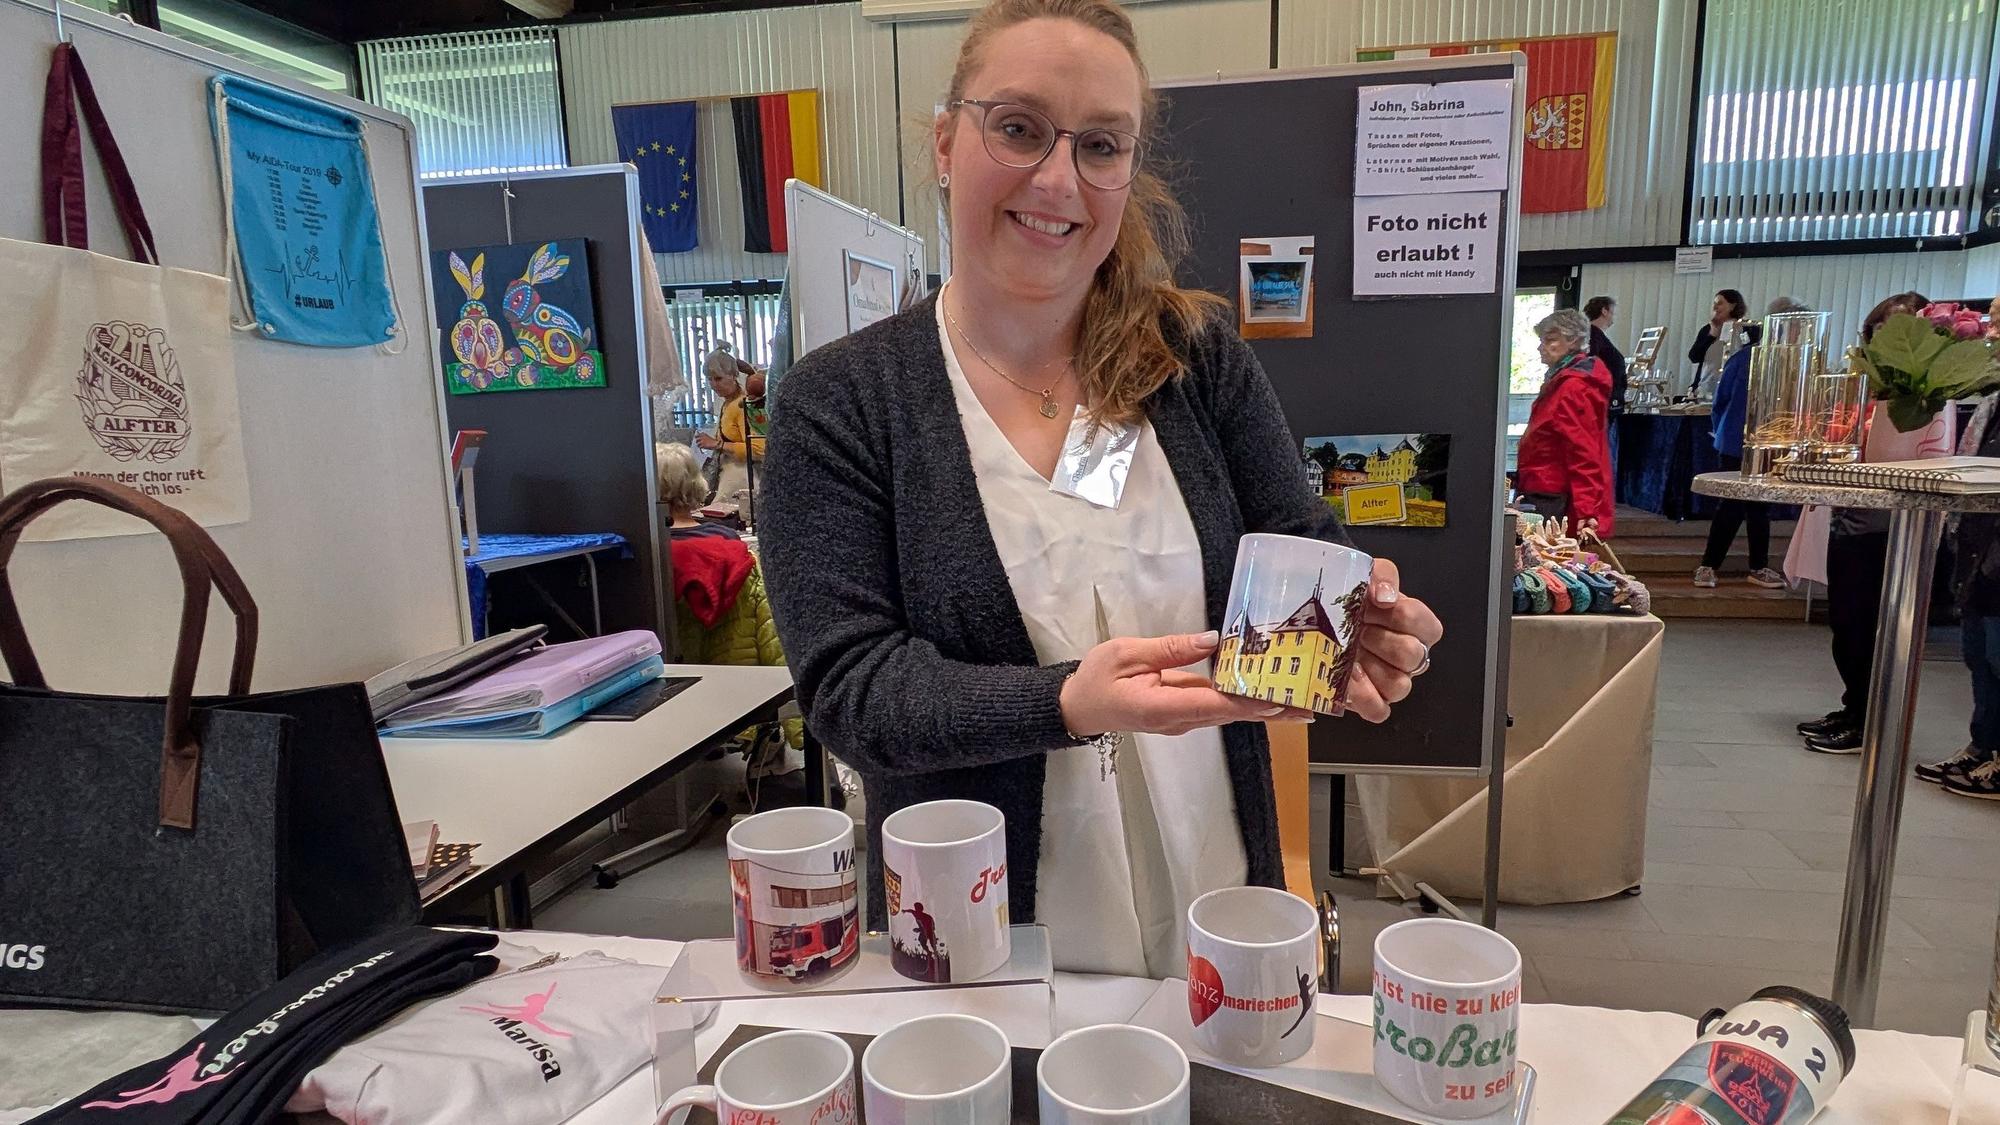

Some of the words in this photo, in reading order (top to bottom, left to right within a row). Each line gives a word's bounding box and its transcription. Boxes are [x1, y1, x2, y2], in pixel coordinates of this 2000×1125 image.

[1369, 101, 1407, 114] John,
[1410, 99, 1465, 112] Sabrina
[1420, 131, 1443, 139] Fotos,
[1367, 141, 1400, 150] Sprüchen
[1401, 141, 1417, 149] oder
[1418, 140, 1448, 150] eigenen
[1449, 138, 1492, 147] Kreationen,
[1430, 155, 1459, 163] Motiven
[1479, 152, 1501, 160] Wahl,
[1407, 164, 1475, 173] Schlüsselanhänger
[1435, 173, 1457, 181] vieles
[1367, 215, 1419, 232] Foto
[1427, 211, 1488, 231] nicht
[1376, 244, 1460, 262] erlaubt
[1467, 243, 1474, 261] !
[1374, 270, 1397, 279] auch
[1399, 270, 1424, 279] nicht
[1426, 269, 1443, 278] mit
[1445, 268, 1476, 280] Handy
[294, 294, 335, 310] #URLAUB
[103, 416, 178, 434] ALFTER
[117, 470, 140, 482] der
[142, 470, 173, 482] Chor
[176, 468, 206, 481] ruft
[140, 483, 161, 496] ich
[164, 483, 183, 495] los
[1361, 499, 1388, 509] Alfter
[1189, 976, 1219, 1004] anz
[1382, 974, 1404, 1004] ist
[1411, 991, 1448, 1015] nie
[1456, 997, 1483, 1016] zu
[1222, 994, 1299, 1013] mariechen
[1716, 1019, 1790, 1050] WA
[488, 1016, 562, 1084] Marisa
[1444, 1083, 1476, 1101] zu
